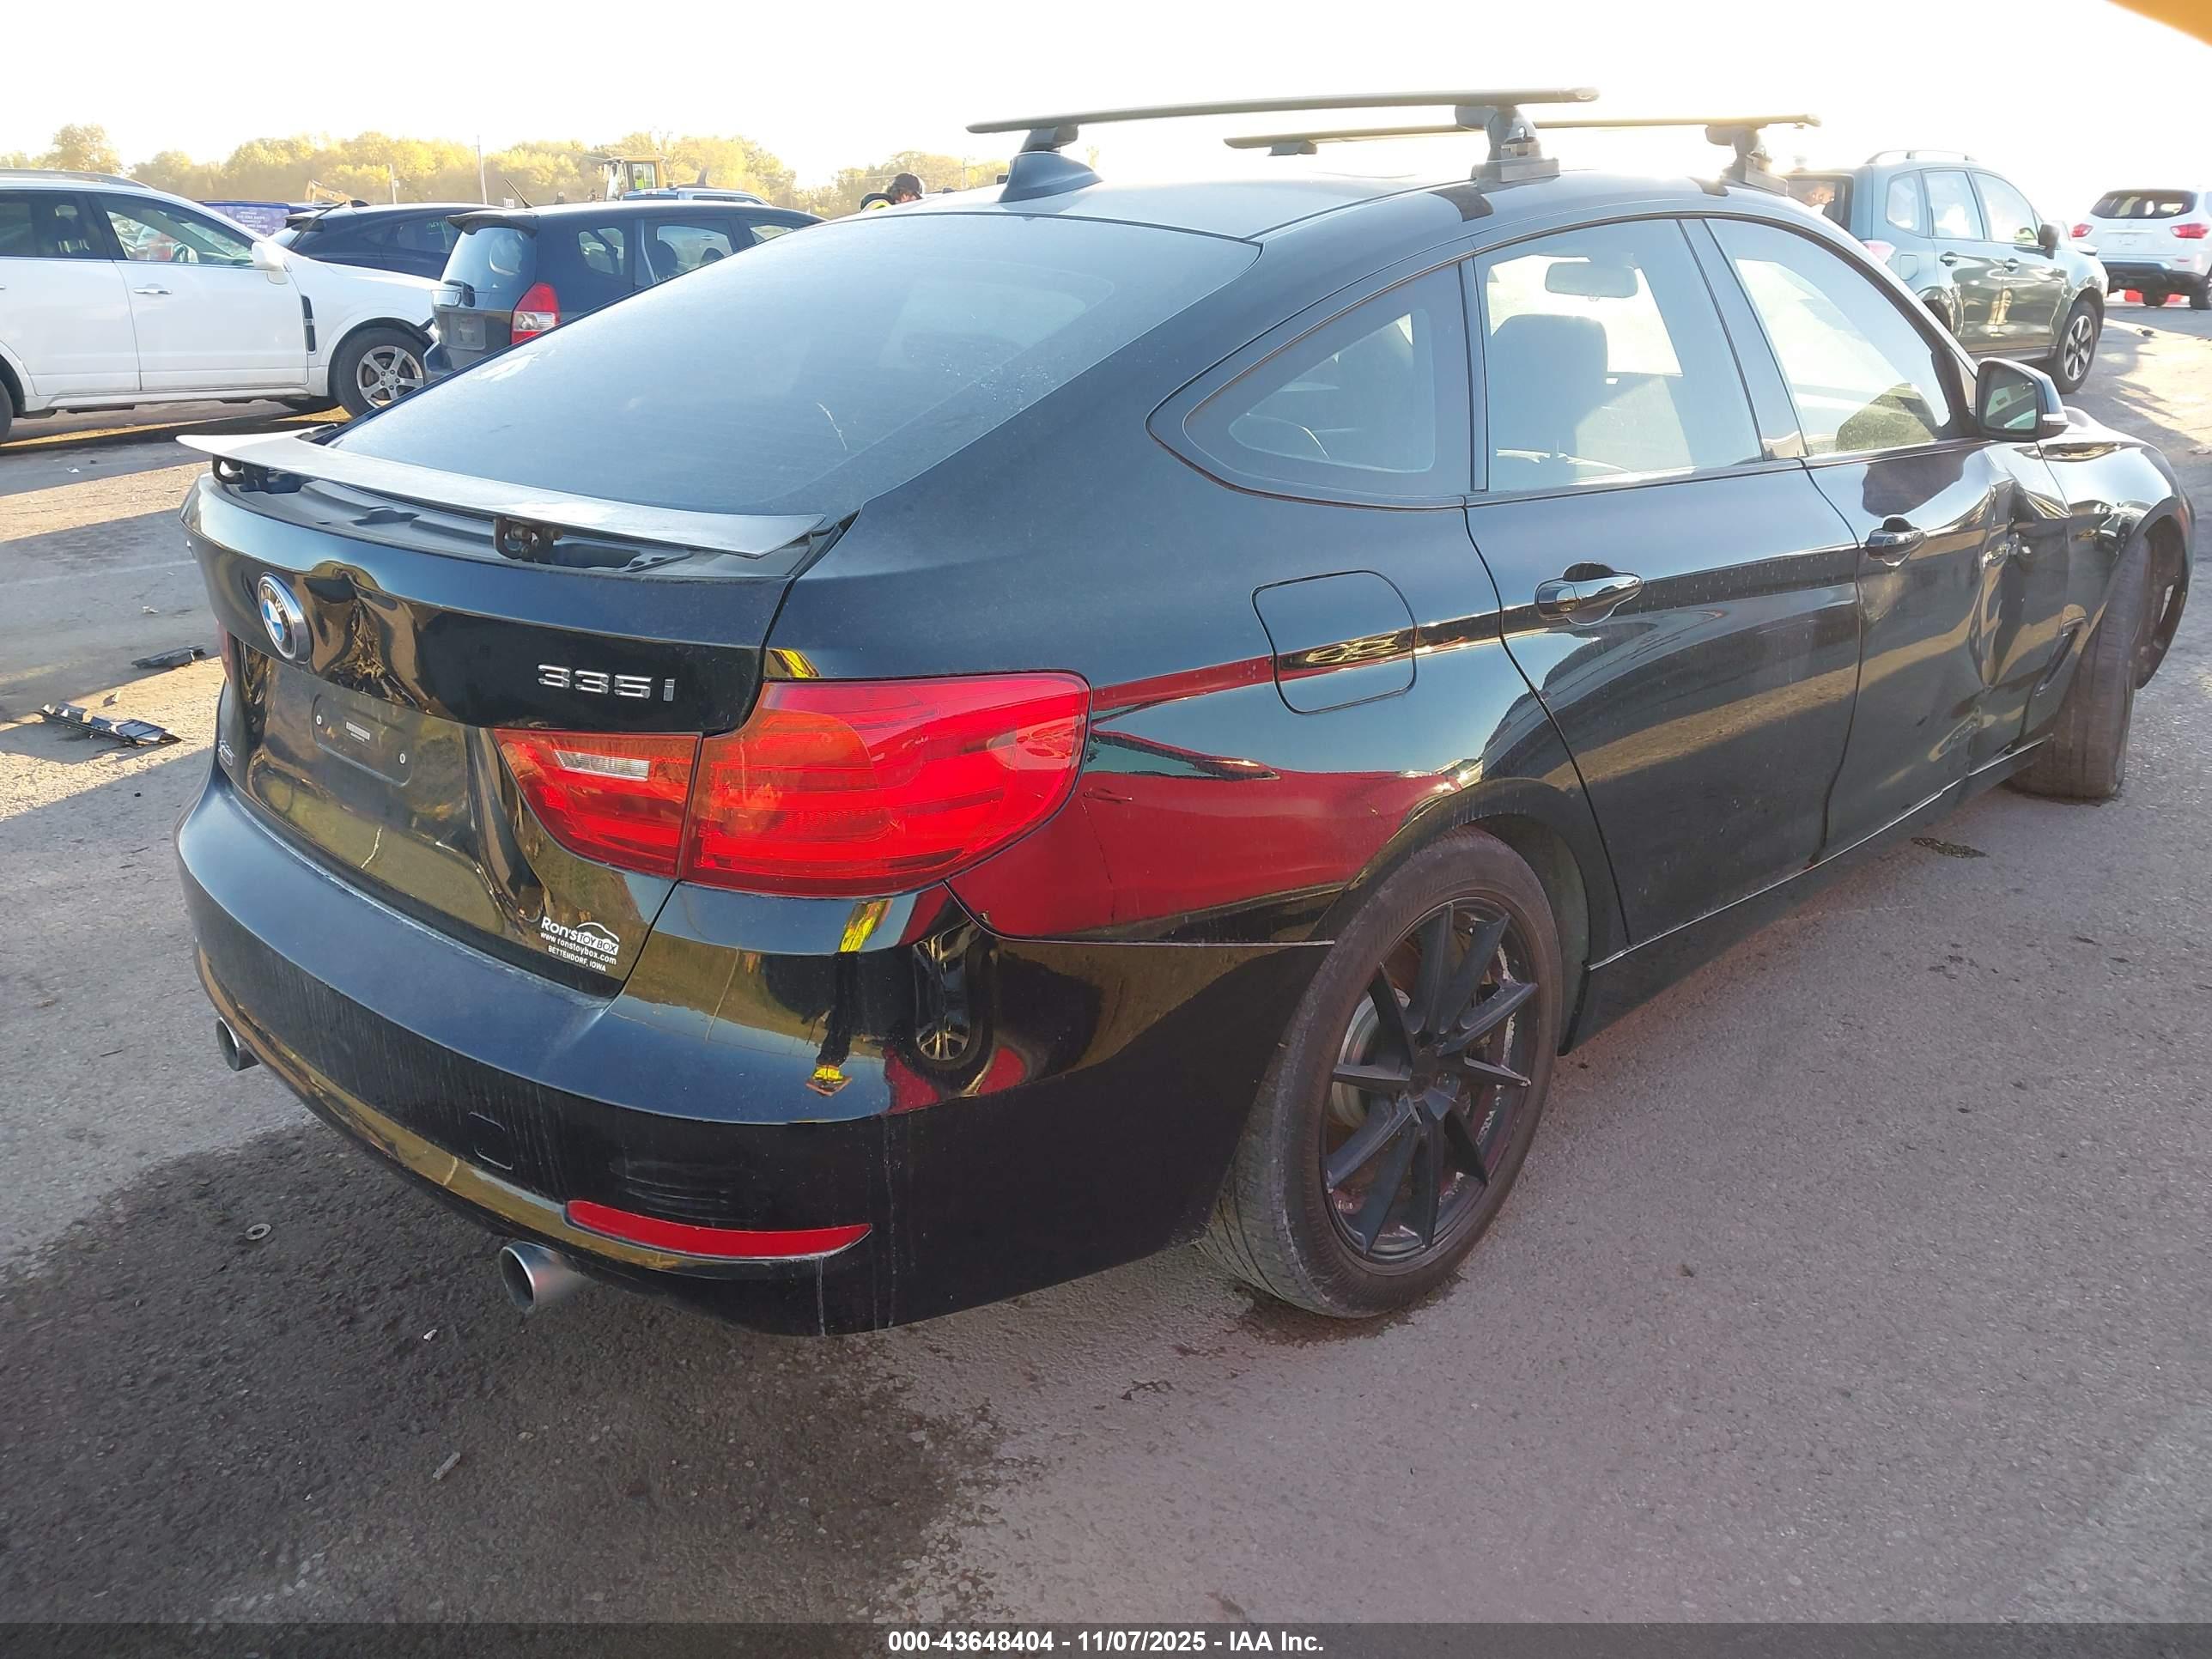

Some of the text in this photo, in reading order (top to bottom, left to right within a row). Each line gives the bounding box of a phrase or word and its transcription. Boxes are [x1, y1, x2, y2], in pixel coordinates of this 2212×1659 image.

[538, 664, 676, 702] 335i
[540, 932, 617, 965] wwwronstoybox.com
[541, 915, 618, 953] Ron's TOY BOX
[589, 960, 606, 972] IOWA
